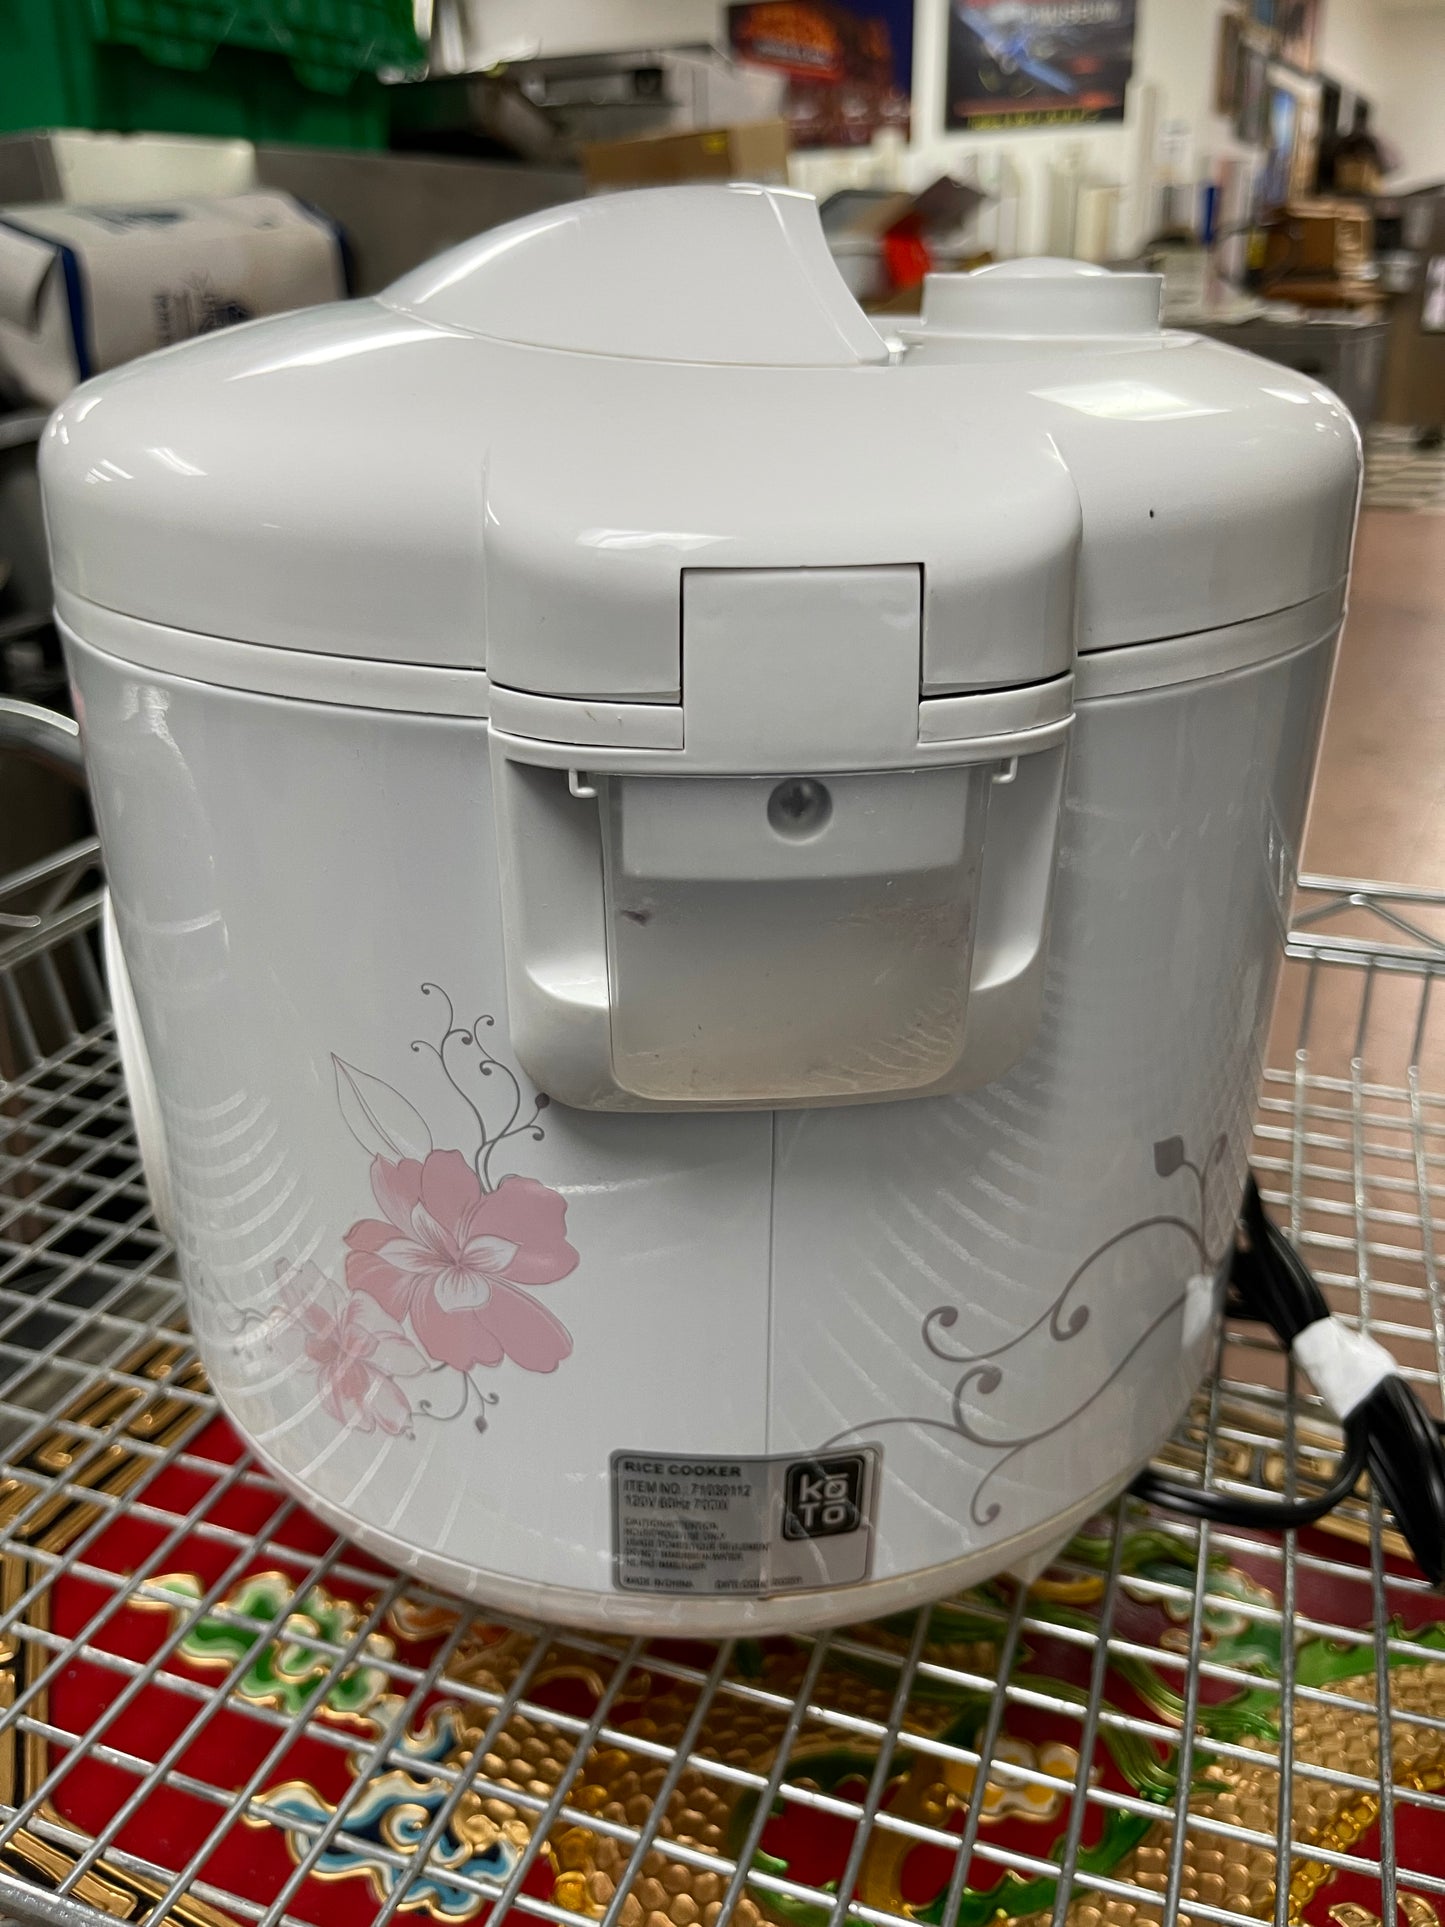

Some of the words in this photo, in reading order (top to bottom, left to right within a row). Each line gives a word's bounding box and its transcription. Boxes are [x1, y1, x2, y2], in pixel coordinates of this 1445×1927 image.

[624, 1461, 663, 1474] RICE
[667, 1464, 742, 1477] COOKER
[624, 1479, 657, 1493] ITEM
